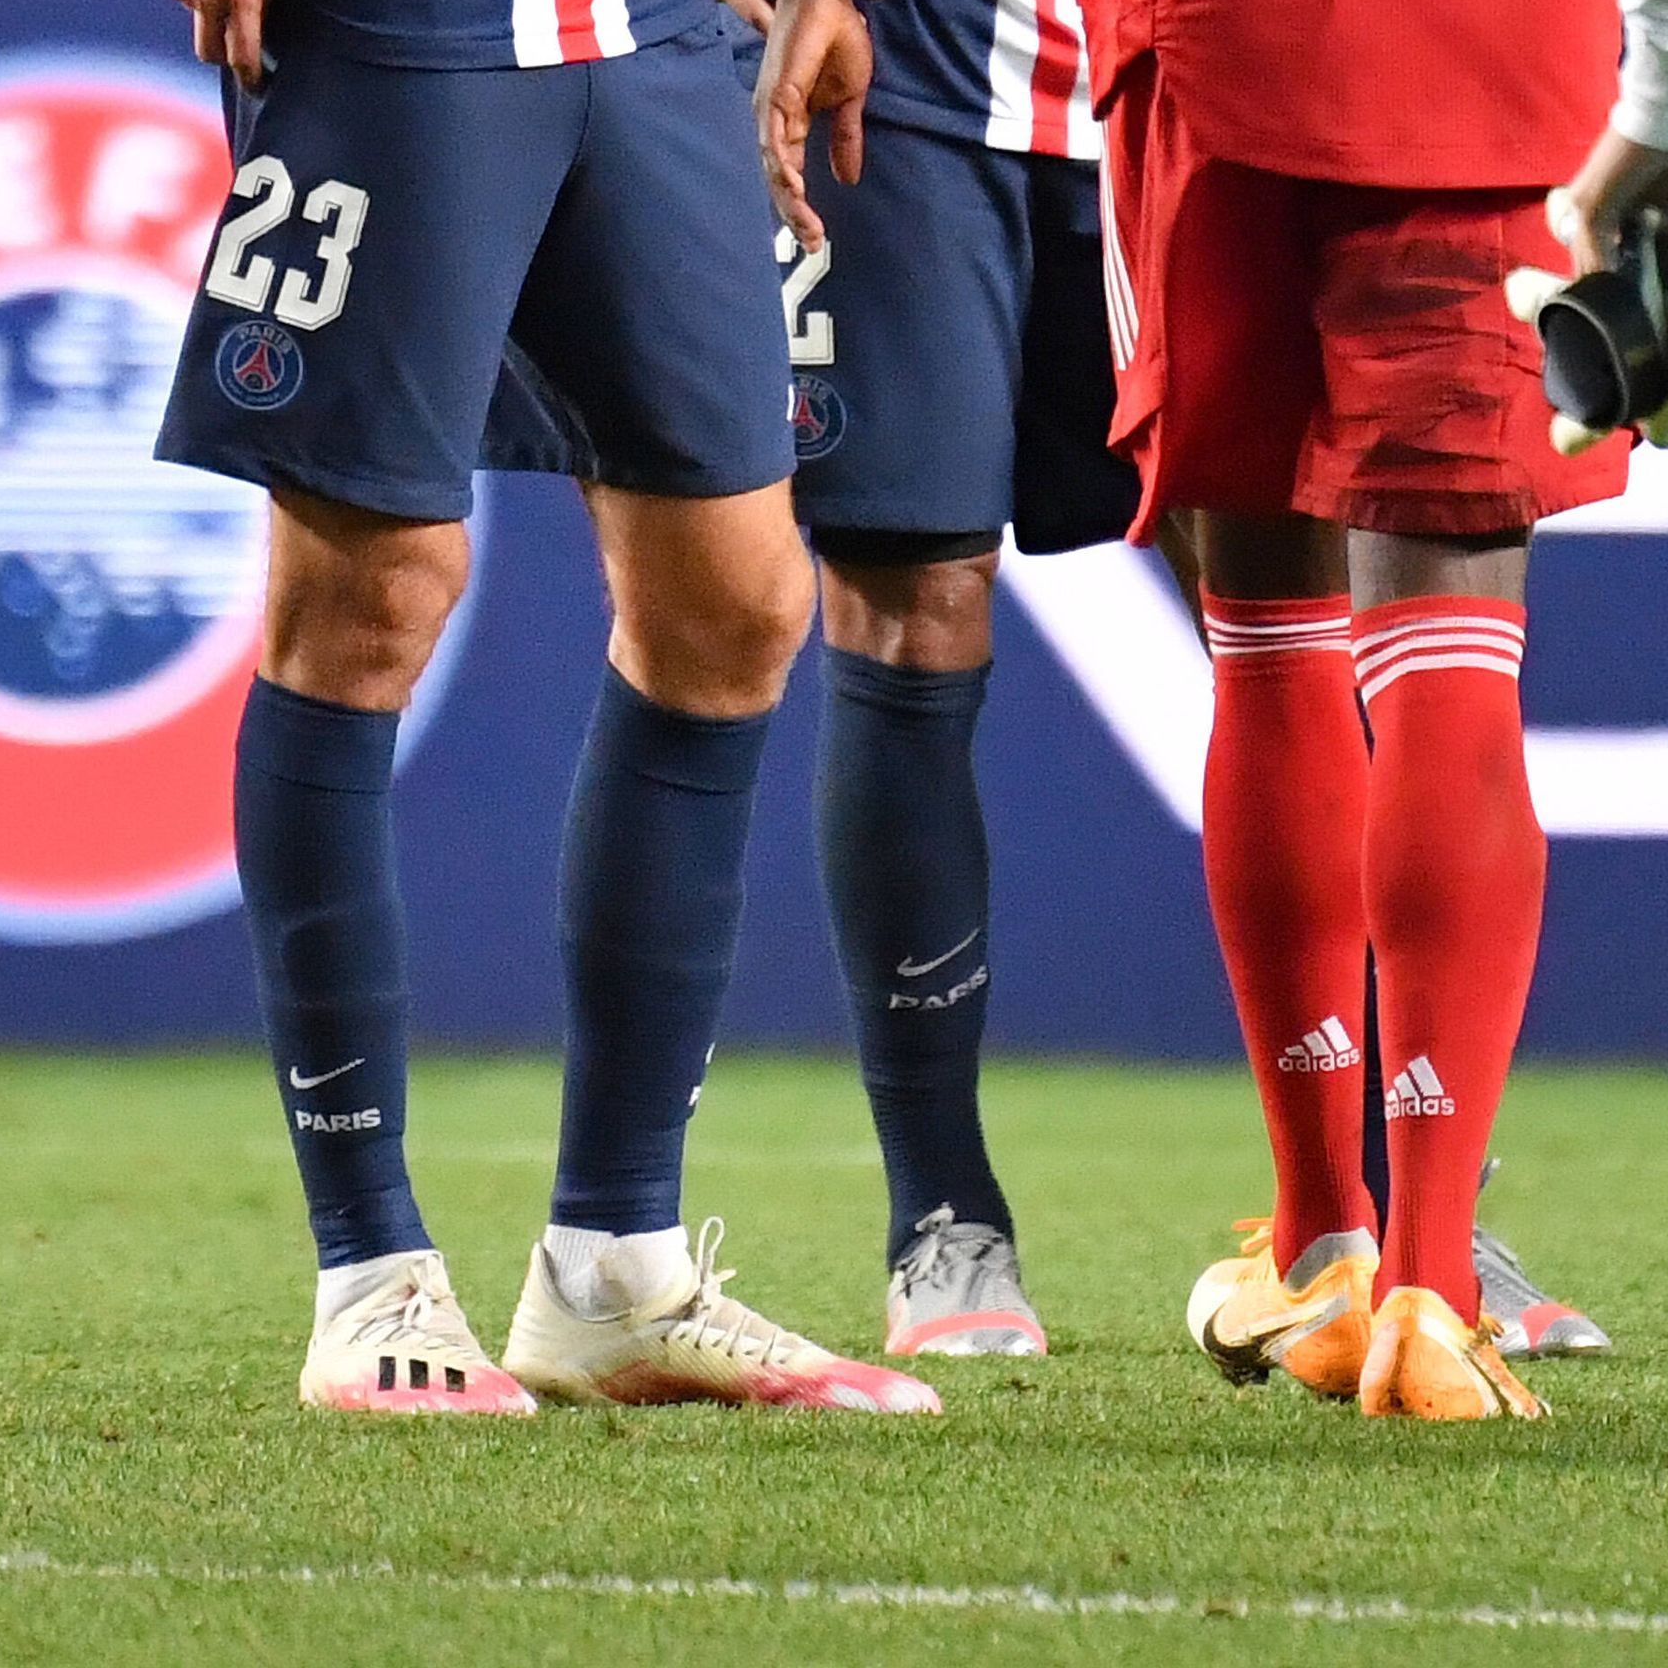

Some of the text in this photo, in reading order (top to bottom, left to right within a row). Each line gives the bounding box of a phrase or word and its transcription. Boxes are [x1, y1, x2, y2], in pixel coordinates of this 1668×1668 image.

[204, 154, 371, 332] 23
[234, 324, 294, 355] PARIS
[1278, 1047, 1361, 1073] adidas
[294, 1106, 382, 1133] PARIS
